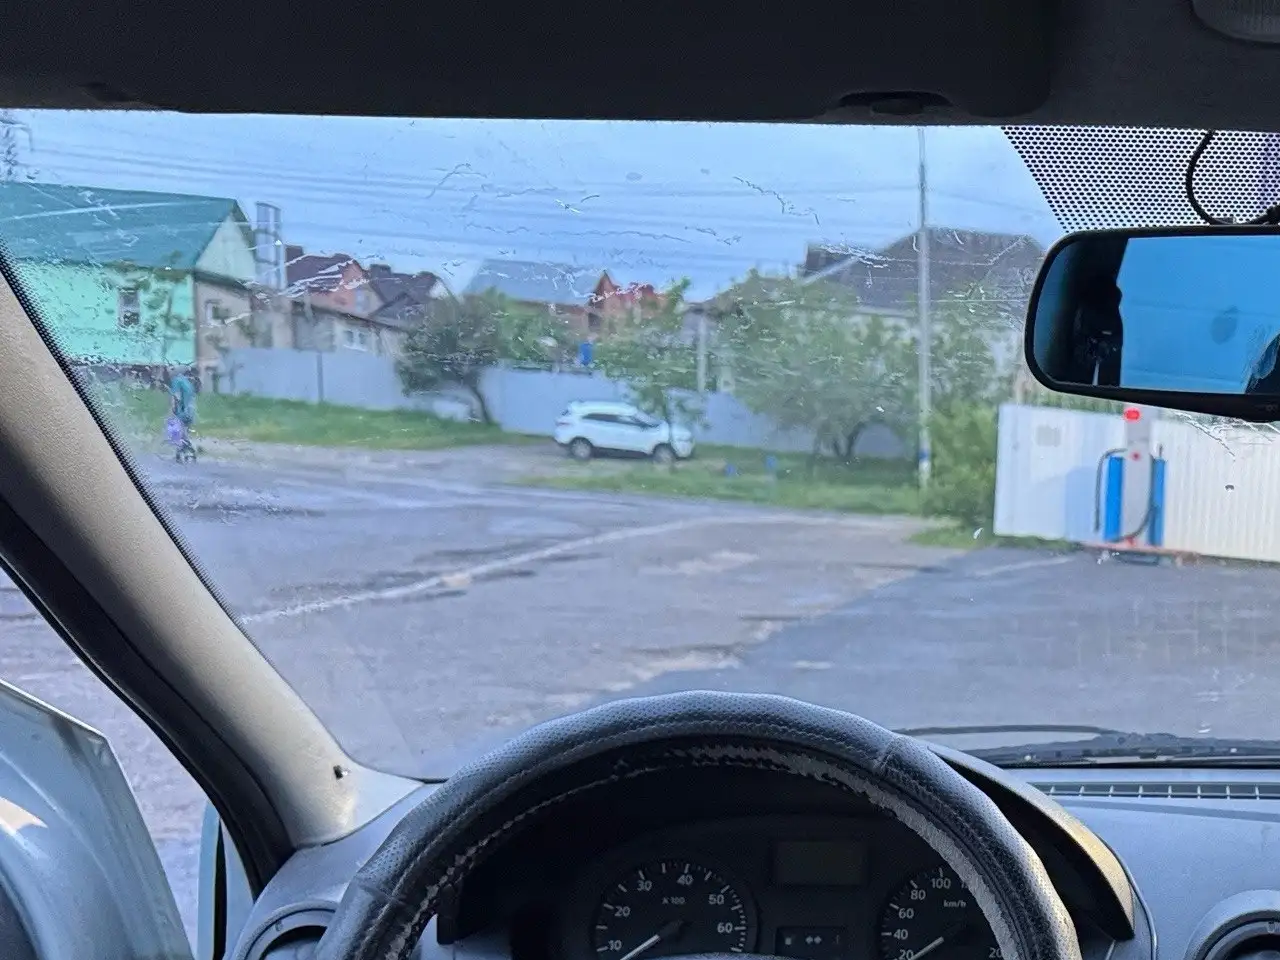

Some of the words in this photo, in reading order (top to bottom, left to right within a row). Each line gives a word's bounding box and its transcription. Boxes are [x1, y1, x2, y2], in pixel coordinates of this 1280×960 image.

[637, 880, 653, 891] 30
[676, 874, 694, 886] 40
[931, 878, 951, 889] 100
[708, 894, 724, 905] 50
[910, 889, 926, 900] 80
[943, 900, 967, 908] km/h
[614, 905, 631, 917] 20
[898, 908, 914, 919] 60
[717, 922, 733, 934] 60
[893, 929, 909, 940] 40
[607, 939, 622, 951] 10
[898, 949, 914, 960] 20
[988, 947, 1002, 958] 20
